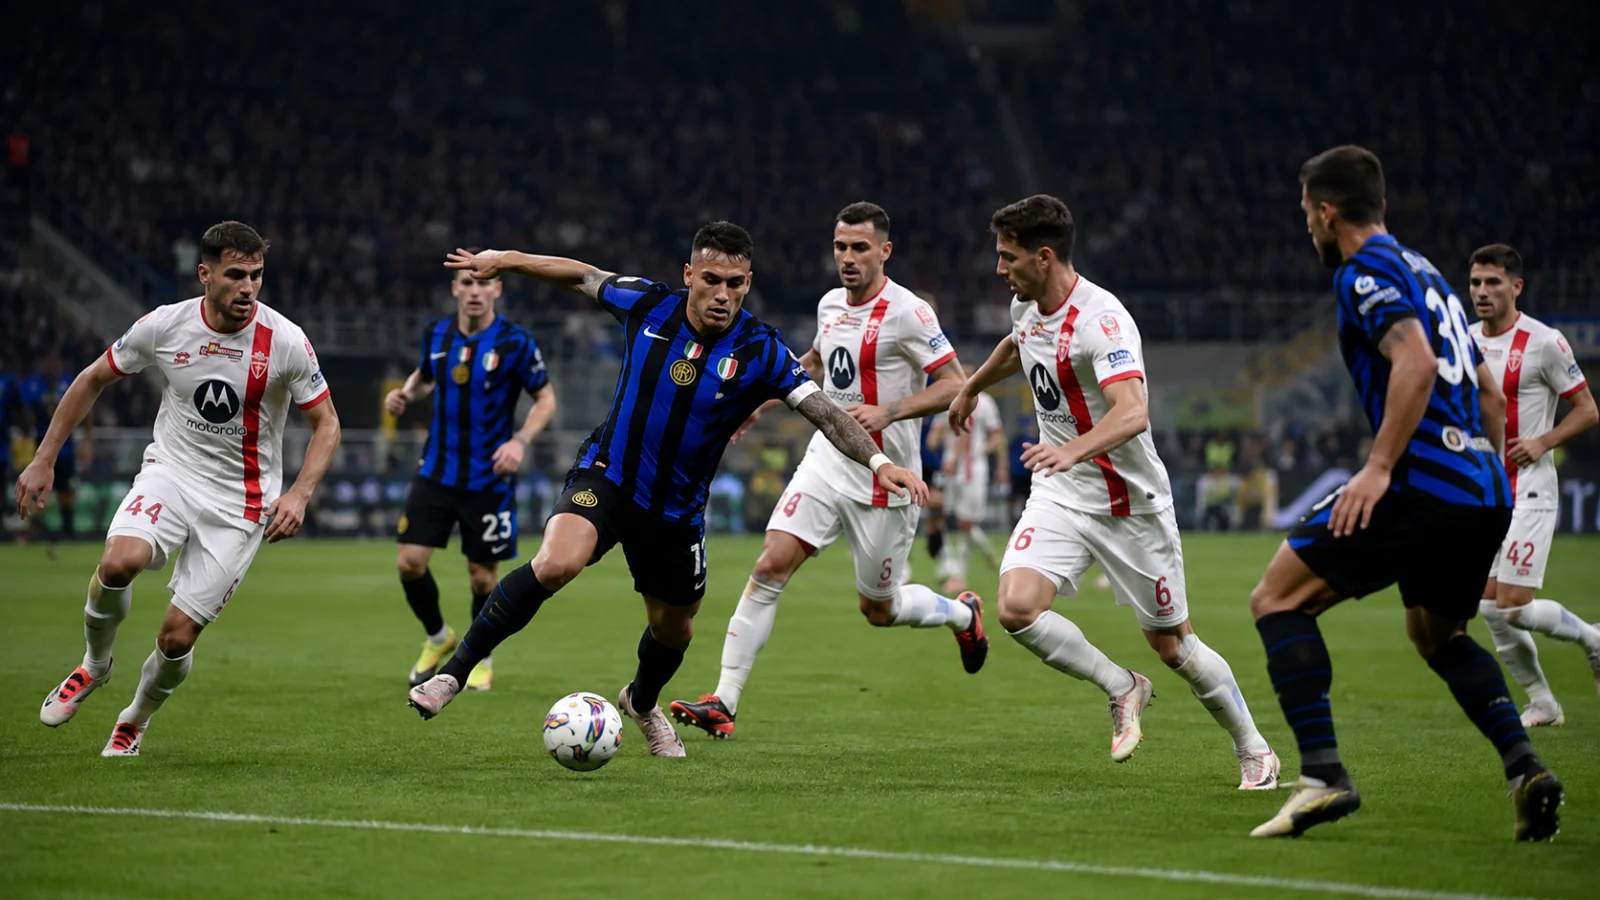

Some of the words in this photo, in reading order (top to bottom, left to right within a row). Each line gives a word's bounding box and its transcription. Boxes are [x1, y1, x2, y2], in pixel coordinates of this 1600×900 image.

[187, 419, 247, 436] motorola
[1036, 410, 1076, 424] otorola
[125, 495, 163, 525] 44
[482, 510, 512, 542] 23
[1506, 540, 1534, 567] 42
[1155, 576, 1171, 607] 6
